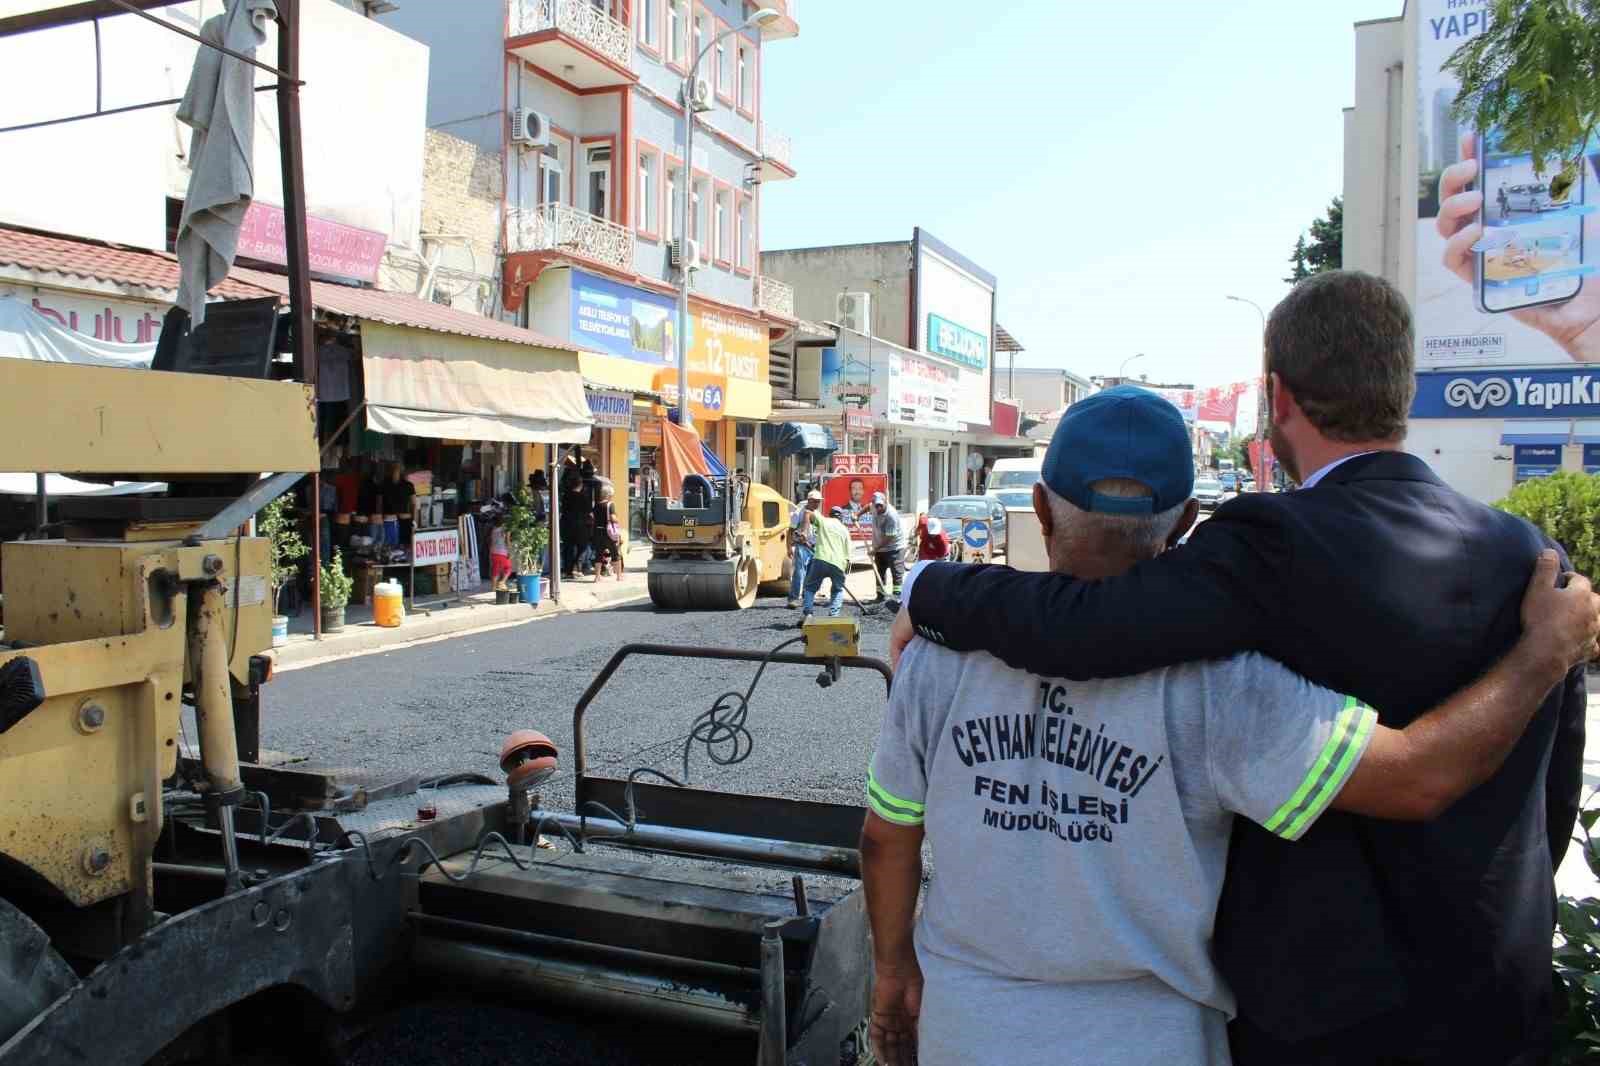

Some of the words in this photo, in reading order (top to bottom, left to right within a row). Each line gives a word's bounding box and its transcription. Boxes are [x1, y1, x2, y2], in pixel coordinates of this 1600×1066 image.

[1430, 8, 1488, 40] YAPI
[705, 338, 723, 373] 12
[1426, 338, 1460, 349] HEMEN
[951, 712, 1037, 768] CEYHAN
[974, 776, 1030, 806] FEN
[1041, 781, 1129, 824] İŞLERİ
[982, 806, 1114, 843] MÜDÜRLÜĞÜ
